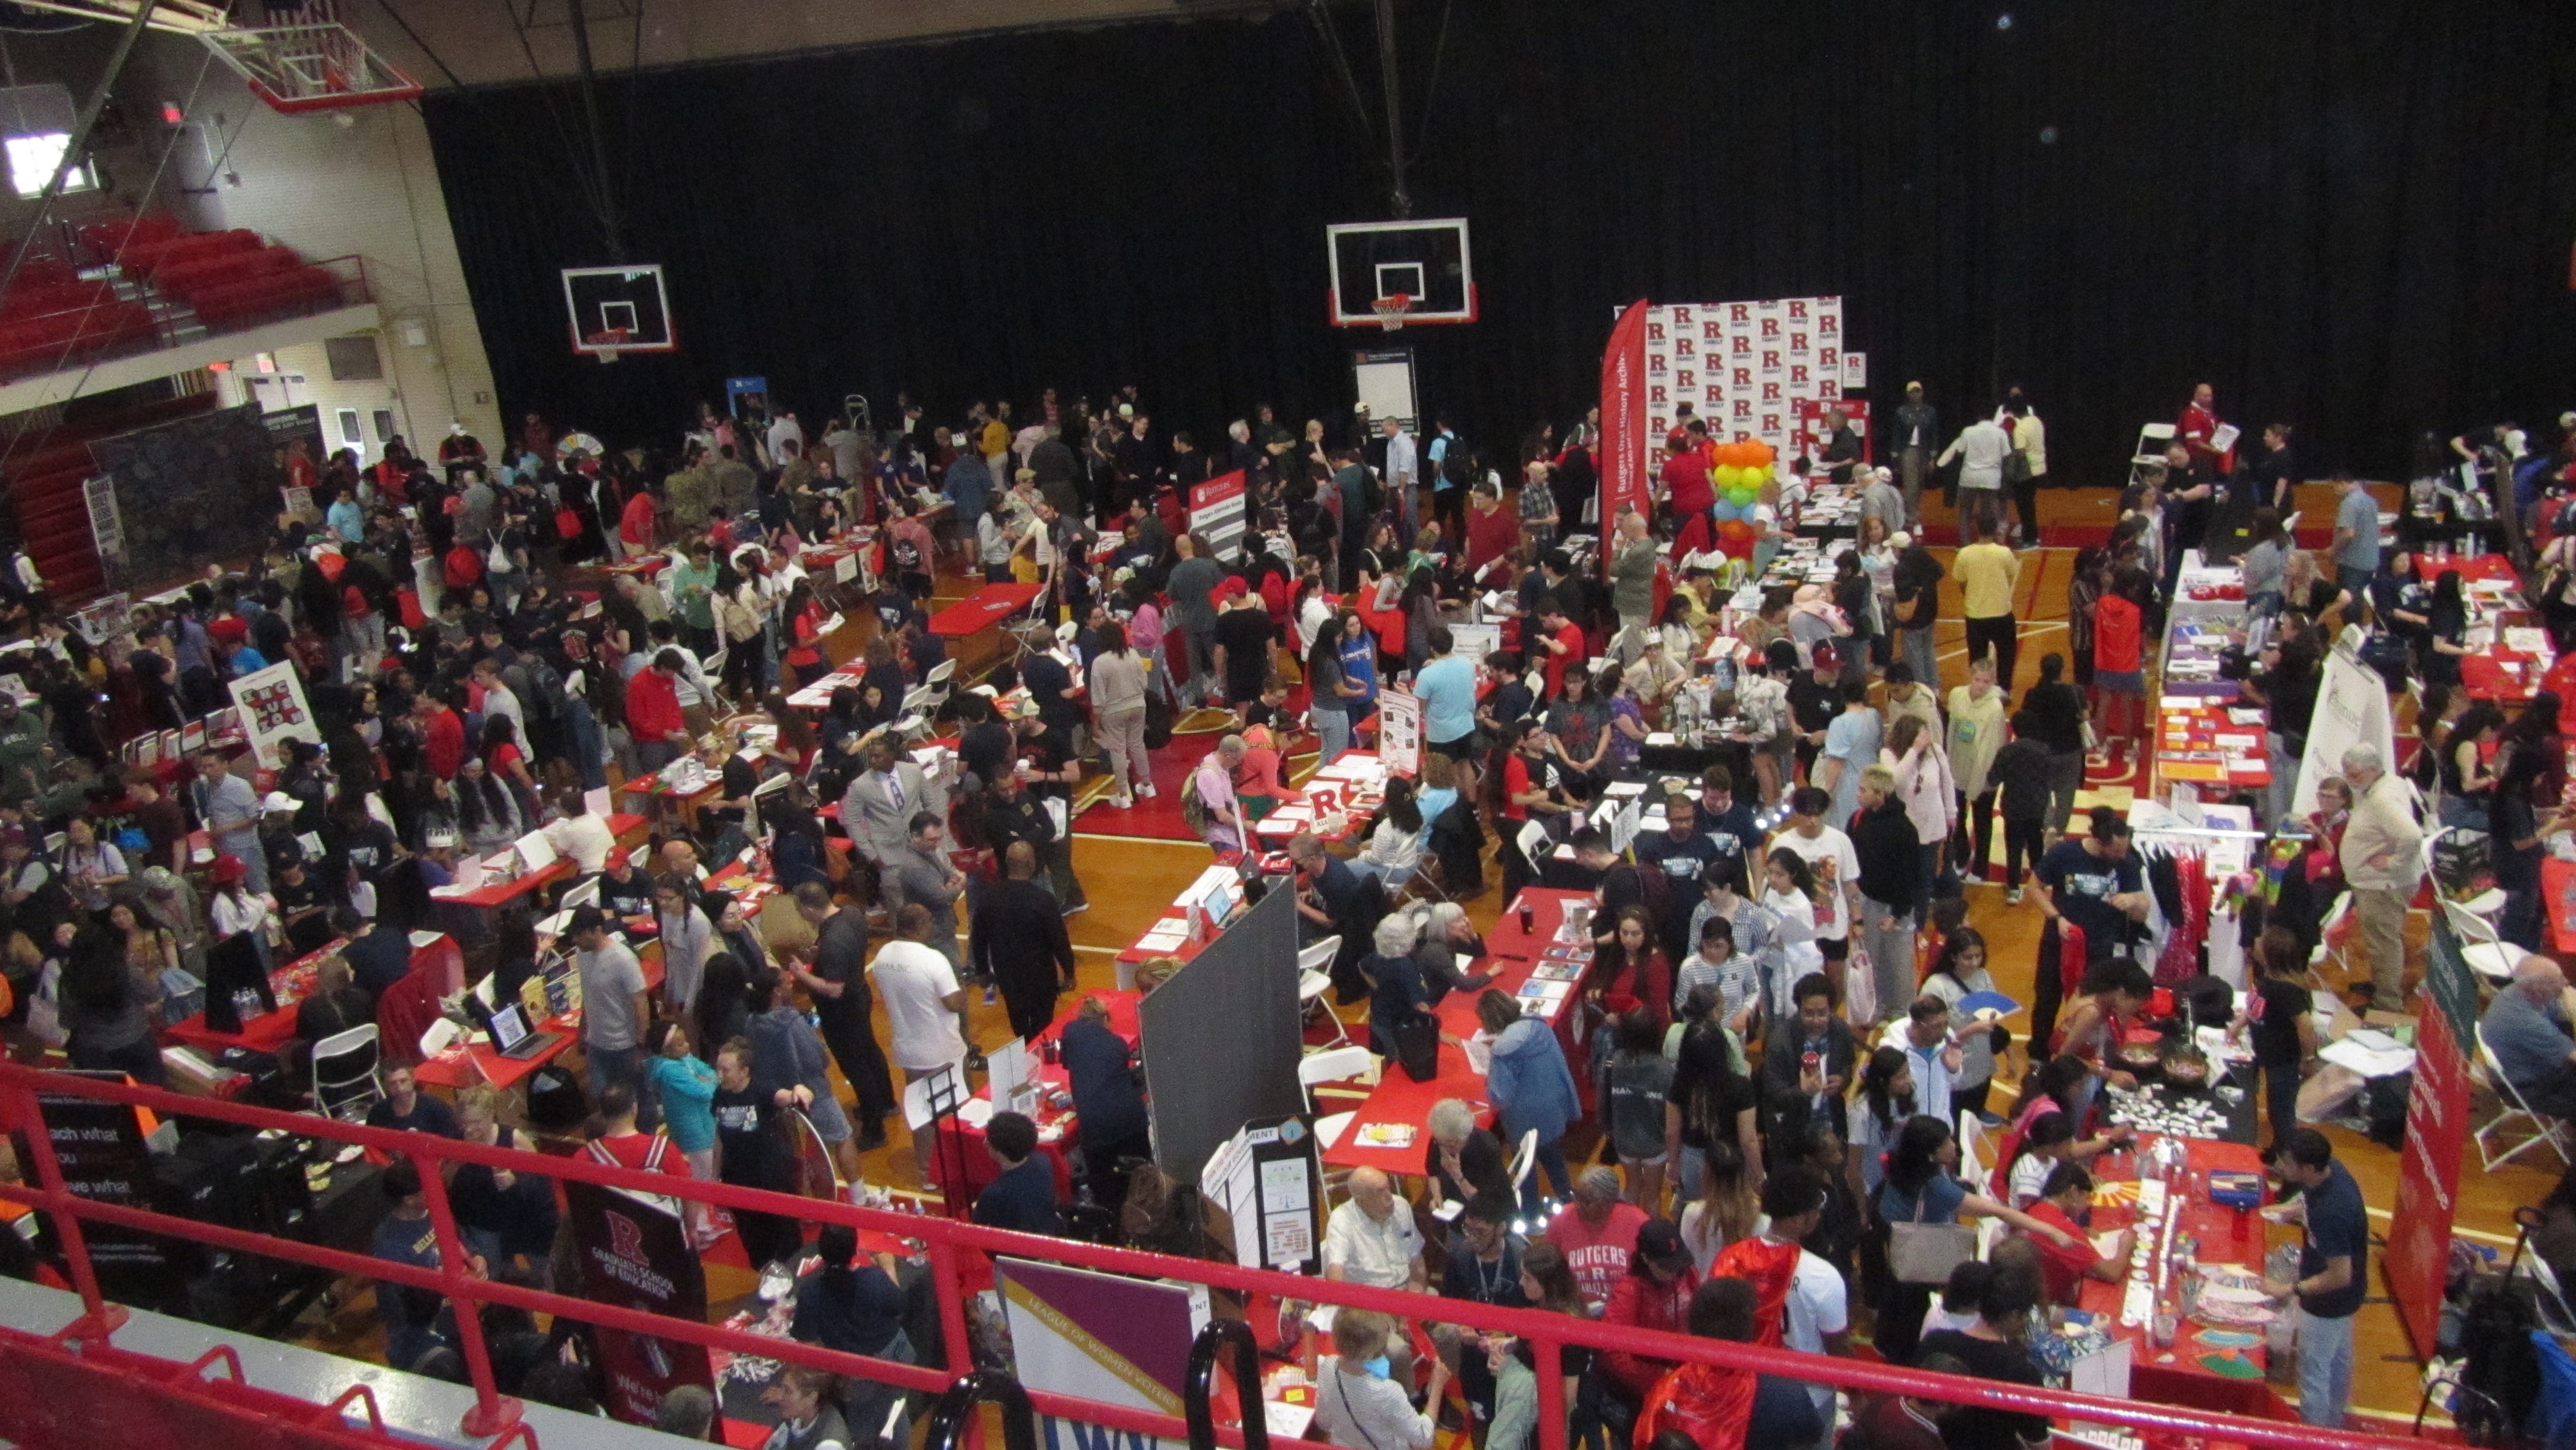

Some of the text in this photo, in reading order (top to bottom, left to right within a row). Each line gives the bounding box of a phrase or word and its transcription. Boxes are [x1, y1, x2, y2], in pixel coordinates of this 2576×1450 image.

[1672, 307, 1693, 323] R
[1729, 304, 1750, 321] R
[1788, 300, 1808, 317] R
[1647, 323, 1666, 339] R
[1703, 321, 1723, 338] R
[1760, 318, 1781, 336] R
[1819, 315, 1838, 333] R
[1676, 338, 1695, 355] R
[1732, 336, 1752, 352] R
[1790, 332, 1809, 350] R
[1649, 354, 1667, 371] R
[1705, 353, 1724, 370] R
[1762, 350, 1782, 367] R
[1819, 347, 1838, 365] R
[1848, 357, 1860, 367] R
[1677, 369, 1696, 386] R
[1733, 367, 1753, 385] R
[1791, 365, 1810, 382] R
[1650, 385, 1668, 402] R
[1705, 385, 1724, 401] R
[1762, 382, 1782, 399] R
[1819, 379, 1837, 397] R
[1619, 391, 1630, 428] History
[1733, 399, 1753, 416] R
[1651, 417, 1668, 433] R
[1706, 416, 1724, 432] R
[1762, 413, 1782, 431] R
[1618, 453, 1627, 493] Rutgers
[1206, 481, 1231, 496] RUTGERS
[1199, 512, 1213, 520] Rutgers
[1309, 789, 1342, 820] R
[80, 1126, 119, 1141] what
[56, 1152, 77, 1164] ou
[92, 1179, 132, 1193] what
[606, 1210, 650, 1267] R
[1568, 1244, 1627, 1268] RUTGERS
[592, 1246, 677, 1294] GRADUATE SCHOOL
[1591, 1267, 1606, 1280] R
[1027, 1296, 1178, 1409] LEAGUE OF WOMEN VOTERS
